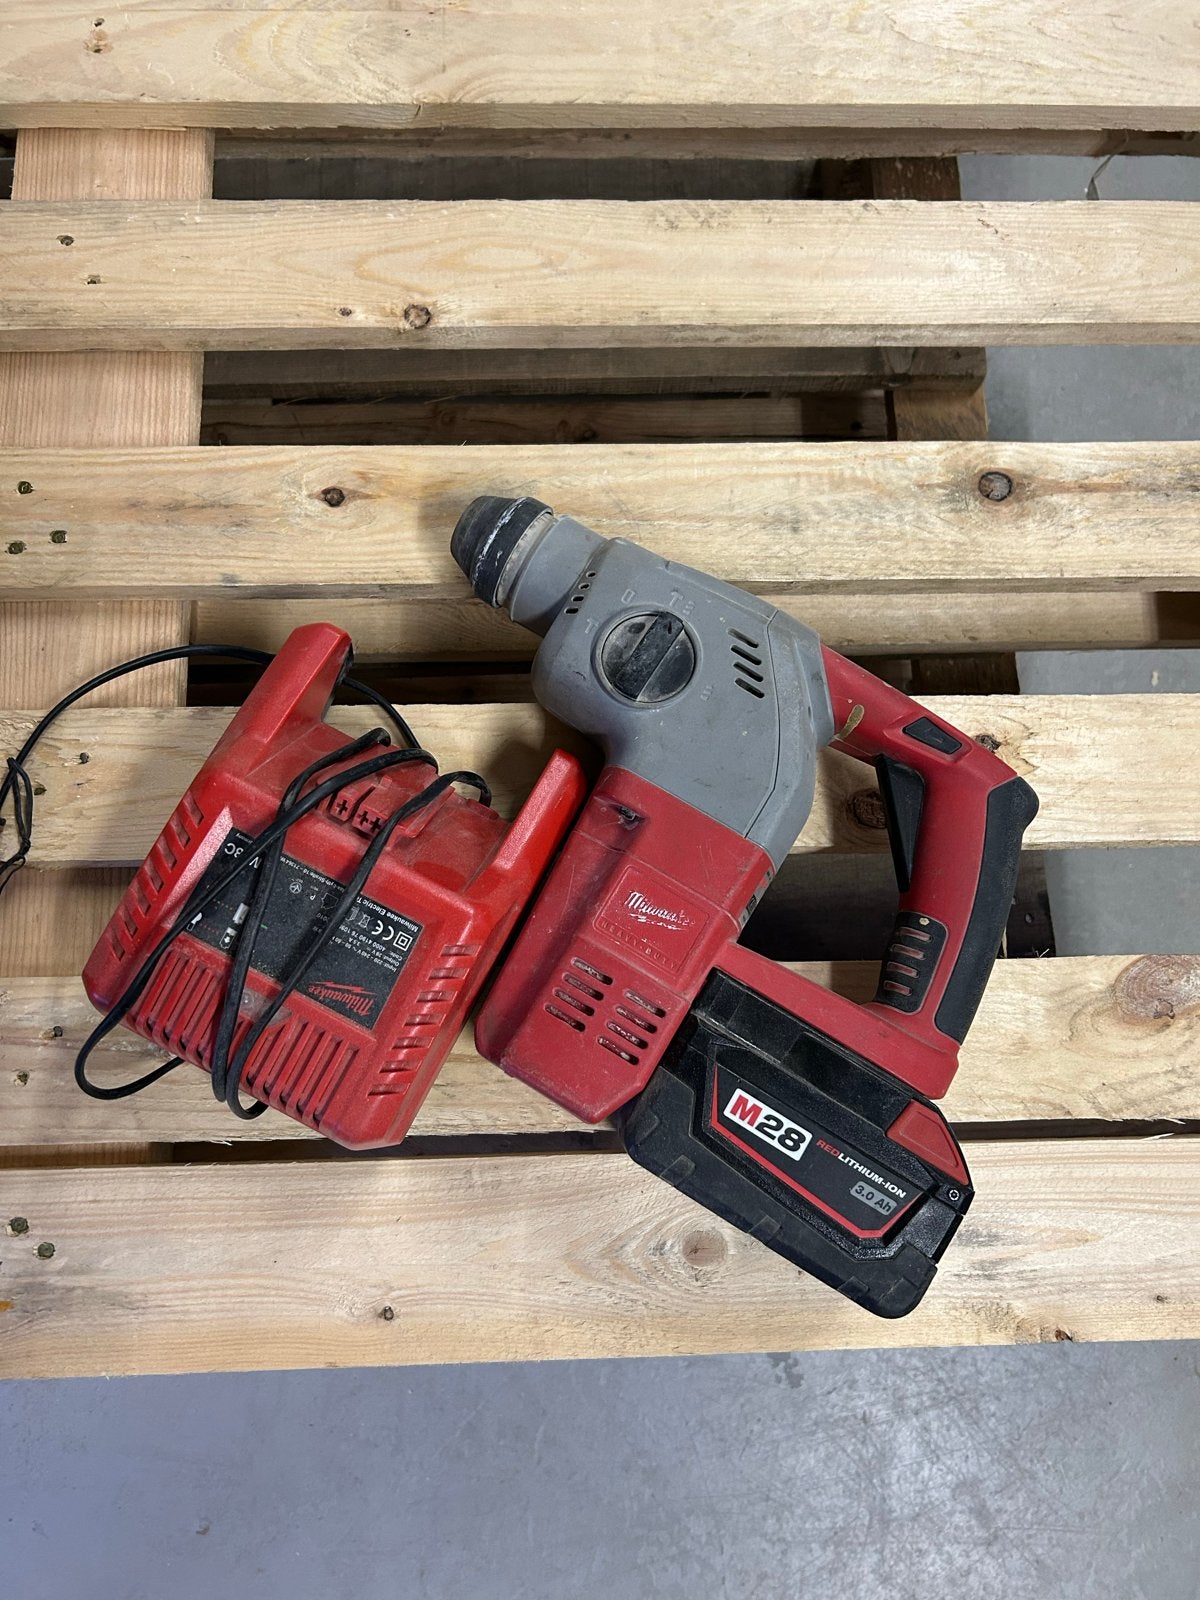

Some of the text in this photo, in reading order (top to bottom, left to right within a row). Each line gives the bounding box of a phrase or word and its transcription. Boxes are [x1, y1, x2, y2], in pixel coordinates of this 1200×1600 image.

[362, 899, 386, 916] Electric
[385, 911, 419, 933] Milwaukee
[308, 984, 376, 1016] Milwaukee
[729, 1093, 807, 1153] M28
[855, 1184, 893, 1214] 3.0 Ah
